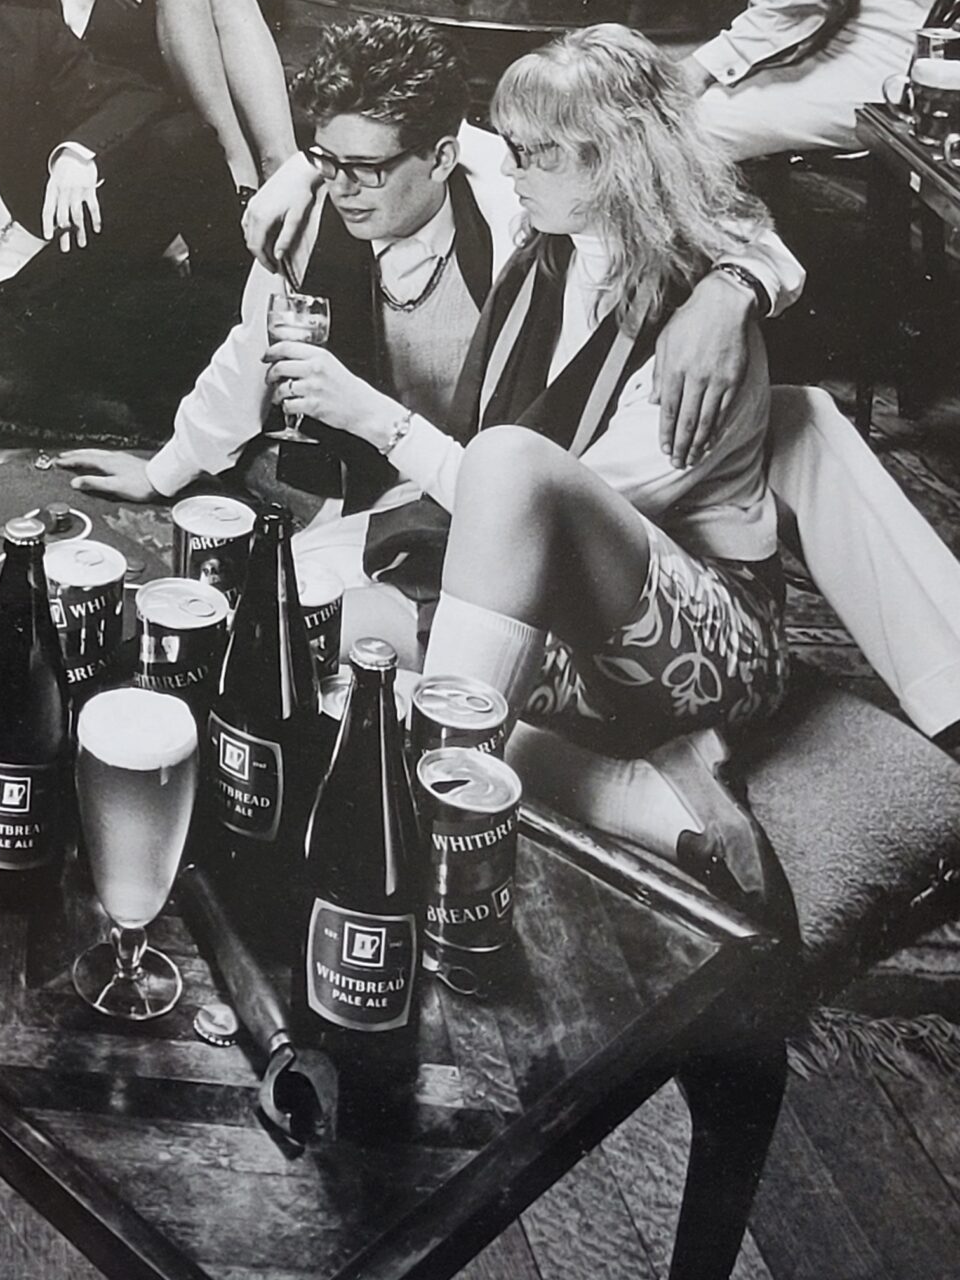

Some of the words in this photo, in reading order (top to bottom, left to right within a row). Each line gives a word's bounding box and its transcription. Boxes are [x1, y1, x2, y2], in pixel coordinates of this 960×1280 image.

[190, 535, 234, 551] BRE
[316, 961, 405, 994] WHITBREAD
[332, 988, 362, 1007] PALE
[365, 997, 388, 1008] ALE
